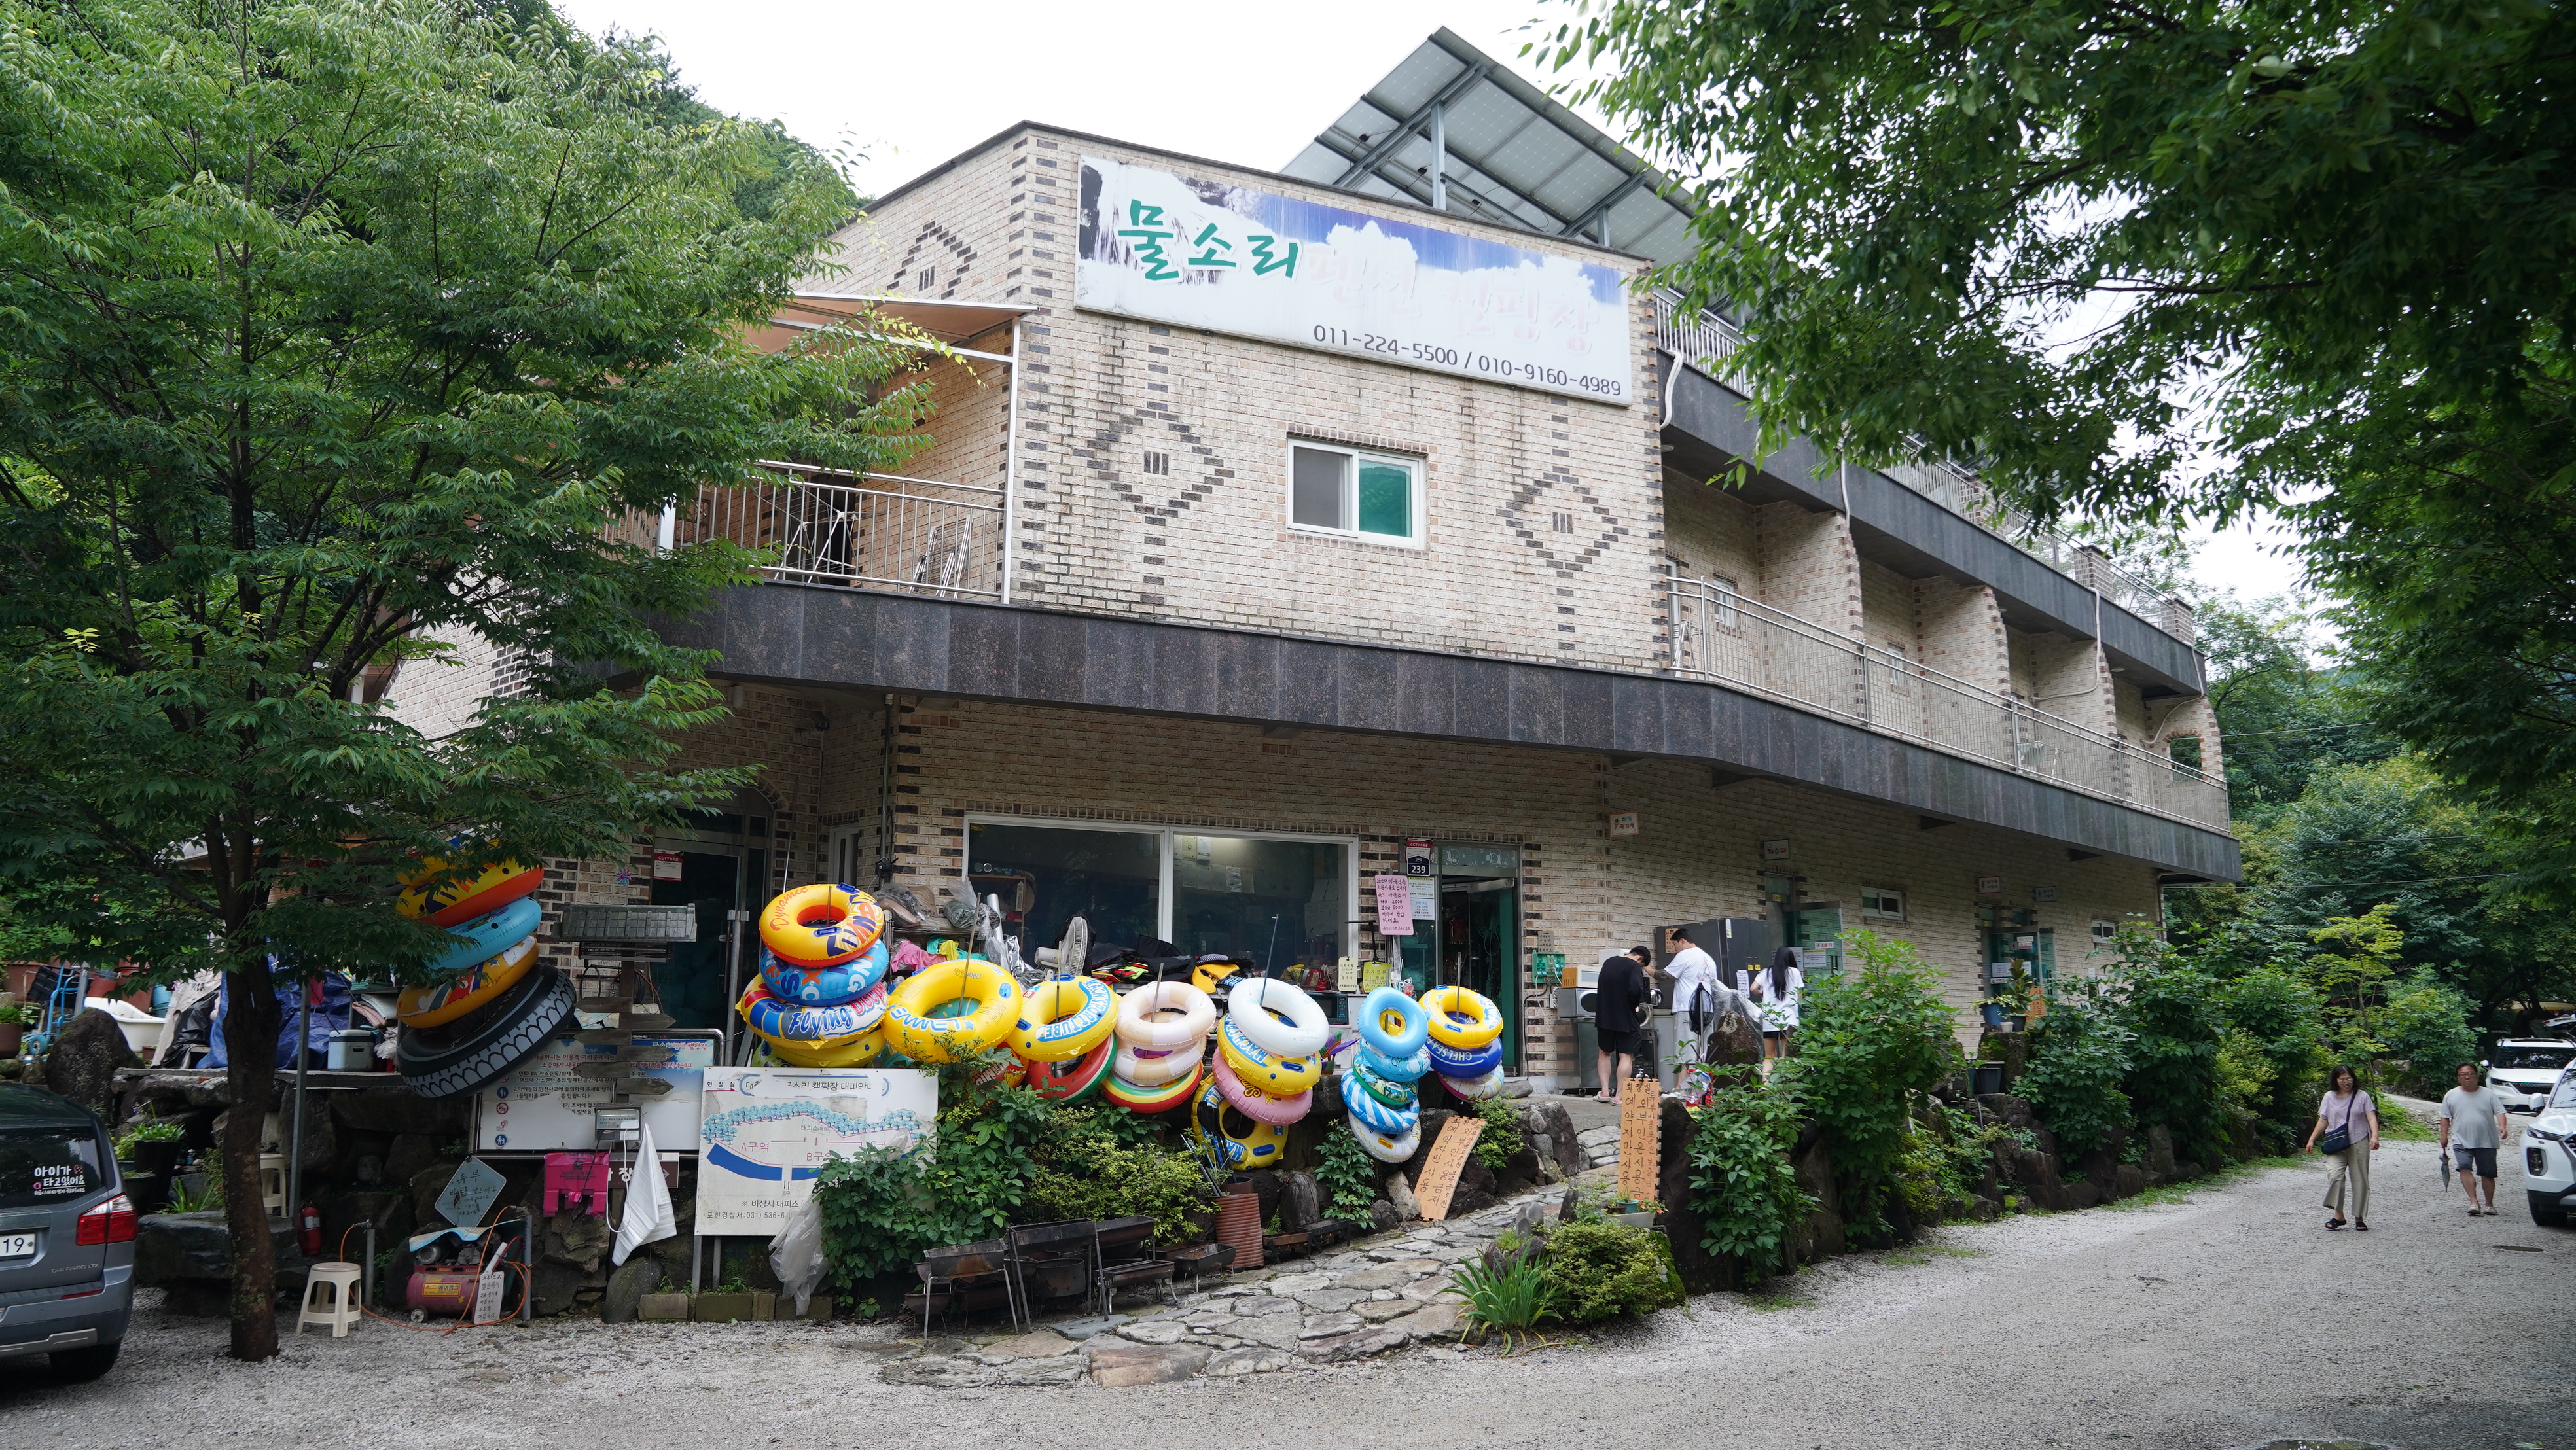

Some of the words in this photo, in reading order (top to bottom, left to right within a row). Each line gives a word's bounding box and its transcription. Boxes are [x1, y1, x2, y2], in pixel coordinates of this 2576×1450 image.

[1118, 199, 1298, 280] 물소리
[1314, 325, 1458, 365] 011-224-5500
[1478, 355, 1620, 395] 010-9160-4989
[1411, 865, 1426, 874] 239
[769, 886, 810, 932] Dynamic
[787, 1008, 851, 1038] Flying
[687, 1042, 708, 1050] 캠핑장
[1431, 1040, 1473, 1061] CHELSEA
[1626, 1082, 1651, 1095] 화장실
[741, 1142, 770, 1152] A구역
[34, 1165, 73, 1177] 아이가
[43, 1175, 86, 1187] 타고있어요
[449, 1186, 468, 1197] 바람
[751, 1199, 775, 1208] 비상시
[776, 1199, 799, 1208] 대피소
[51, 1264, 86, 1274] ORLANDO
